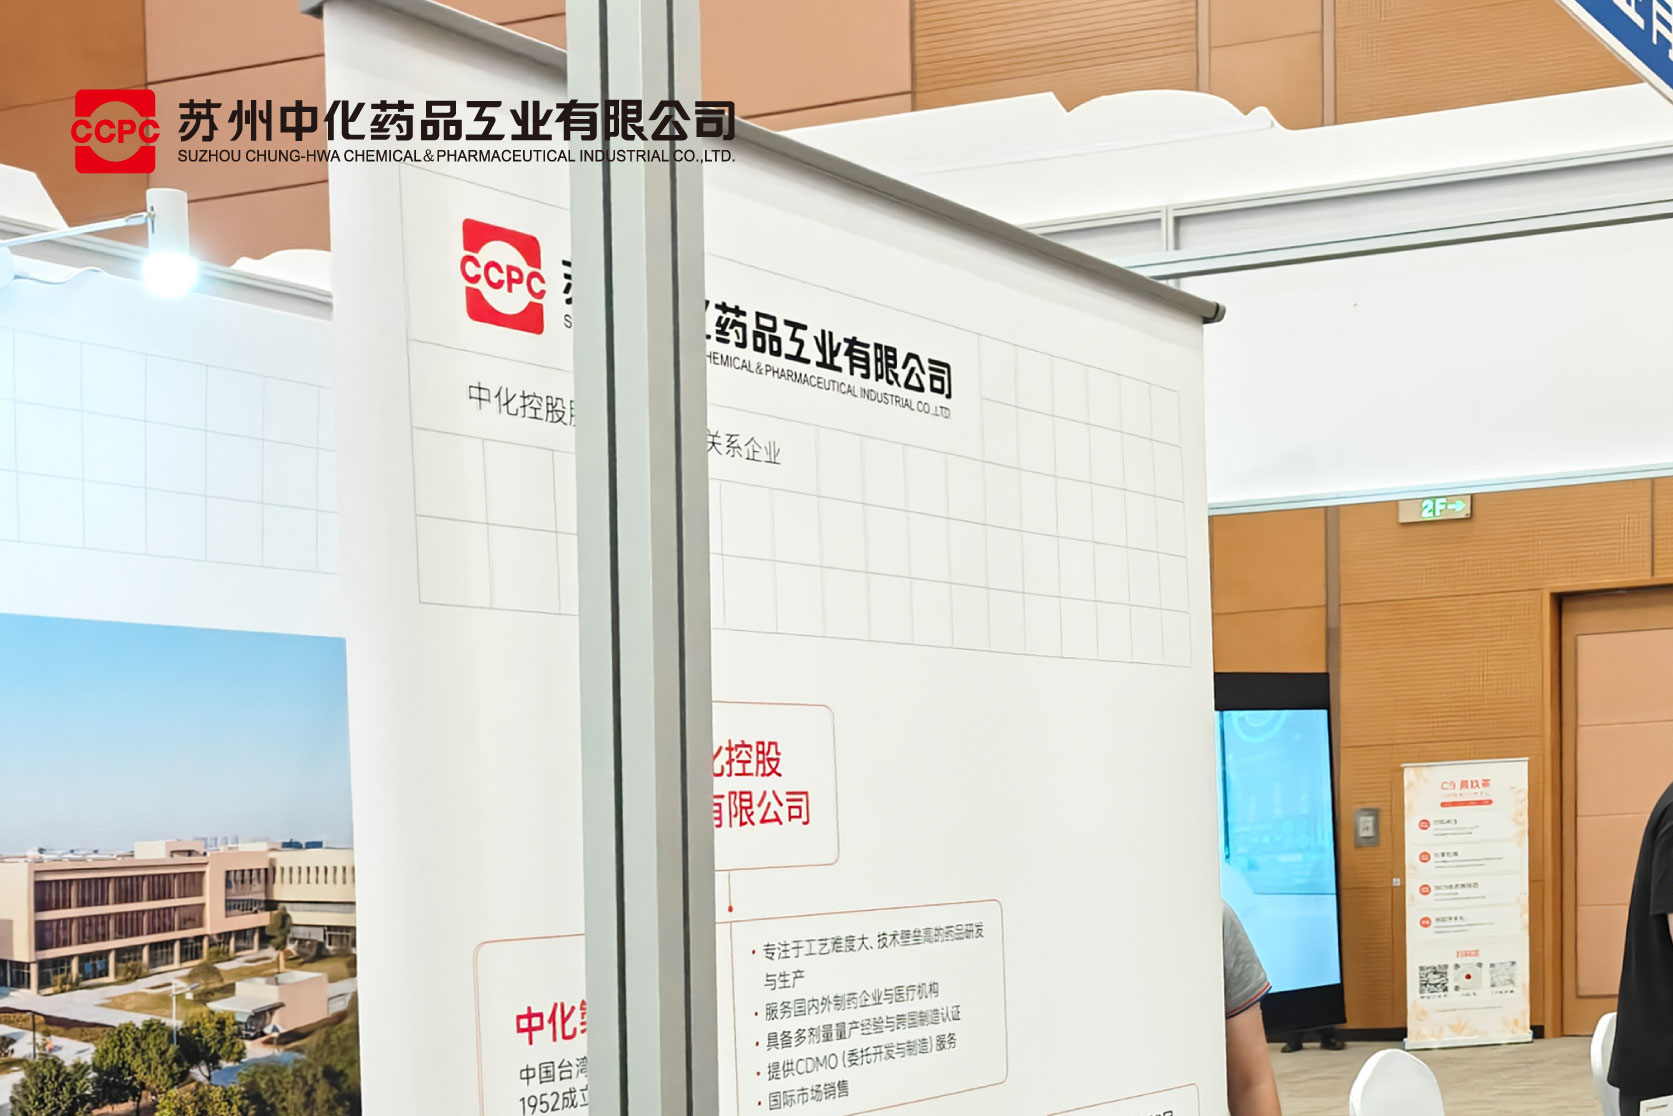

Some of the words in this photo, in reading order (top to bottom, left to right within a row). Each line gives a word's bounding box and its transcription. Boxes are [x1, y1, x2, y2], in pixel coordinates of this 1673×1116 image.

[460, 254, 546, 300] CCPC
[705, 299, 952, 400] 药品工业有限公司
[860, 387, 915, 412] INDUSTRIAL
[706, 430, 781, 465] 关系企业
[1421, 497, 1447, 518] 2F
[764, 968, 805, 992] 与生产
[765, 981, 940, 1021] 服务国内外制药企业与医疗机构
[515, 999, 587, 1046] 中化
[768, 1079, 849, 1111] 国际市场销售
